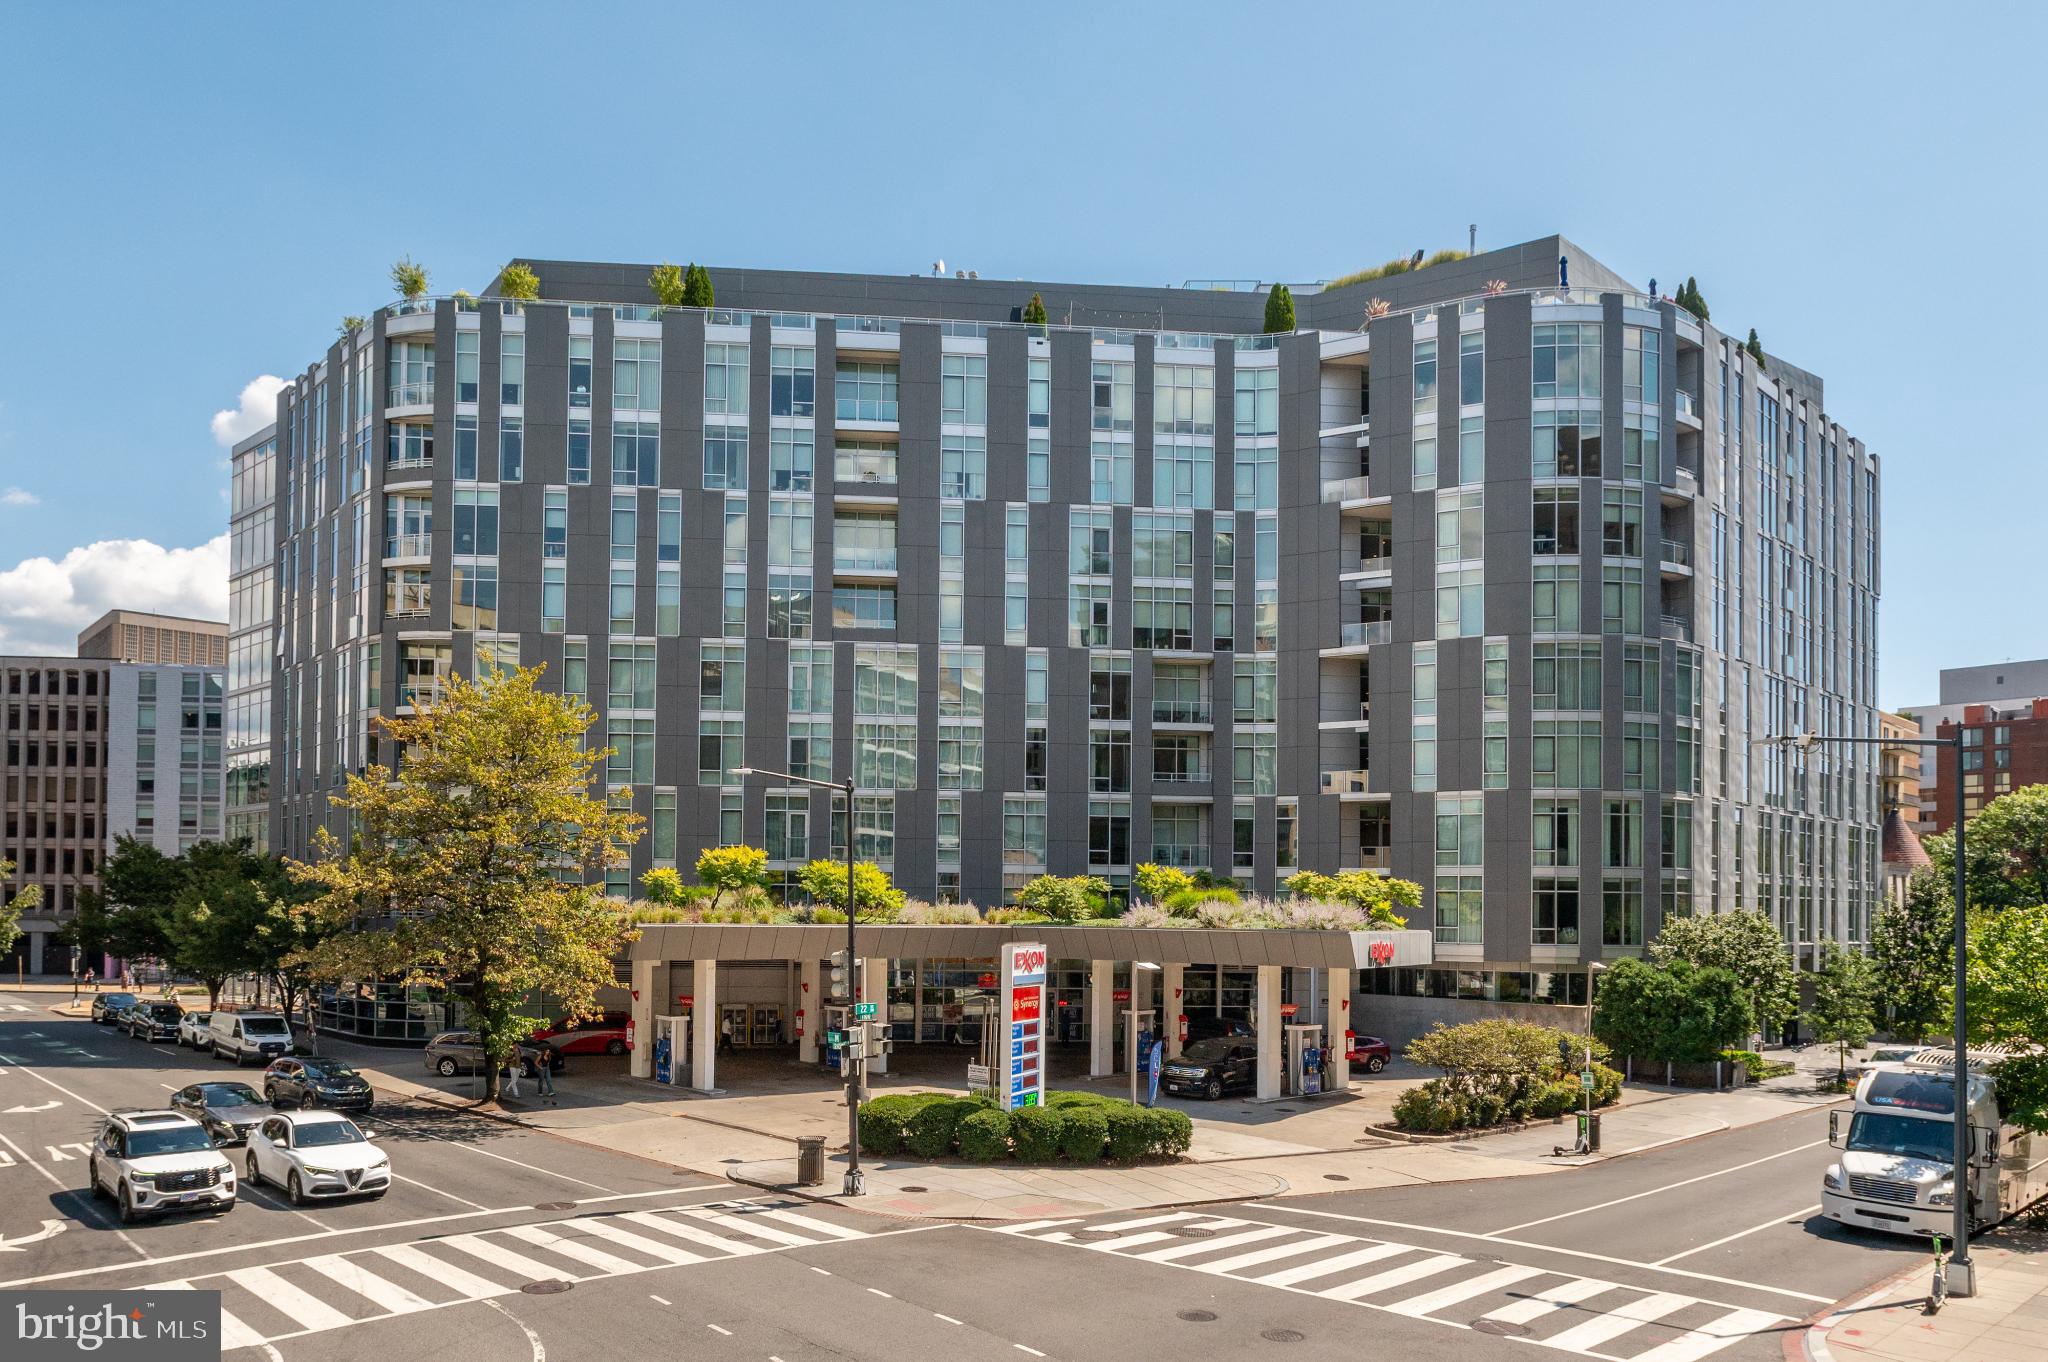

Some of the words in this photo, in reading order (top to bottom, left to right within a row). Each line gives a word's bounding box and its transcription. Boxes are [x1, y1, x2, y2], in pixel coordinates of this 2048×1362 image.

[1371, 942, 1395, 964] EXXON
[1015, 950, 1045, 973] EXXON
[860, 1005, 868, 1013] 22
[1020, 999, 1039, 1010] Synergy
[1874, 1096, 1893, 1104] USA
